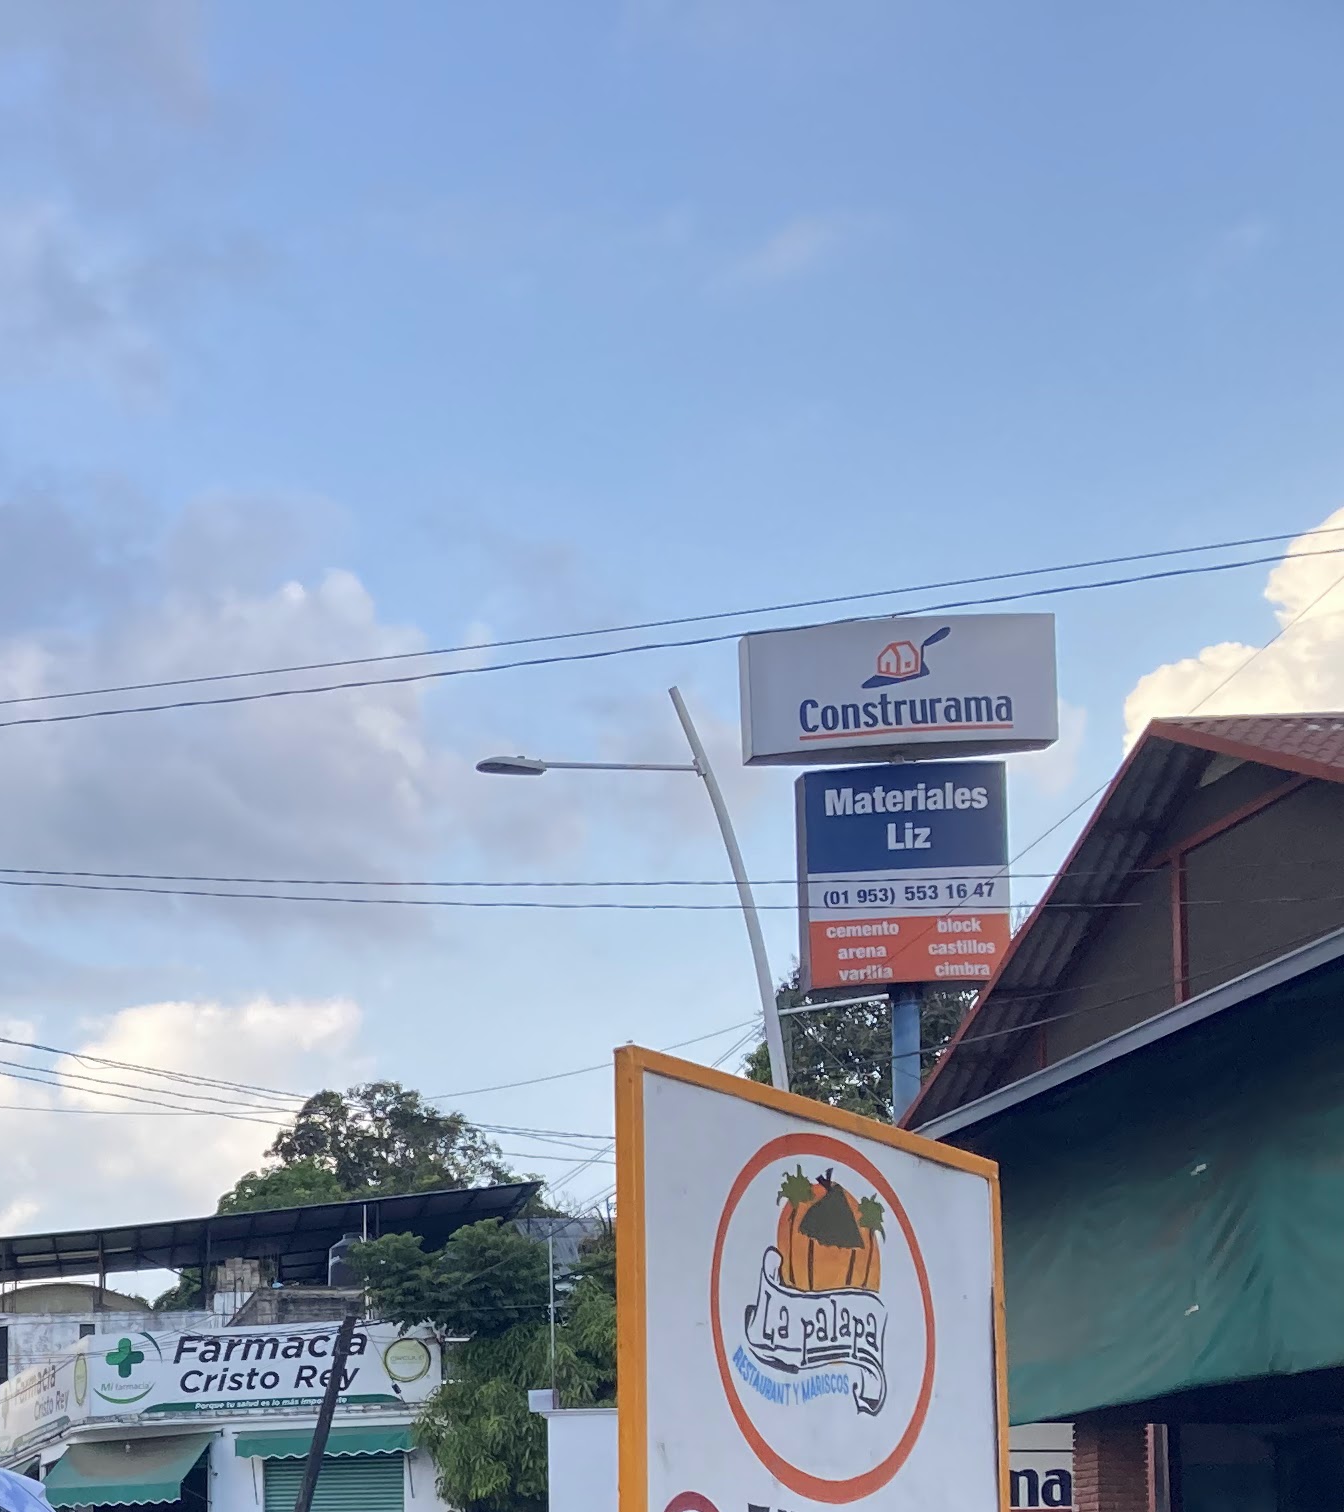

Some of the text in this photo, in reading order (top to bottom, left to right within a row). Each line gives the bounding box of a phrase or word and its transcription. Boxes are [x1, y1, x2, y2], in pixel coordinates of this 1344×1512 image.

[799, 693, 1013, 733] Construrama
[824, 782, 989, 817] Materiales
[887, 822, 931, 850] Liz
[823, 882, 995, 908] (01 953) 553 16 47
[826, 921, 899, 939] cemento
[937, 918, 982, 933] block
[838, 945, 887, 960] arena
[928, 939, 995, 956] castillos
[839, 964, 893, 981] varilla
[935, 962, 990, 977] cimbra
[763, 1290, 879, 1366] La palapa
[180, 1365, 360, 1394] Cristo Rey
[732, 1345, 849, 1406] RESTAURANT Y MARISCOS
